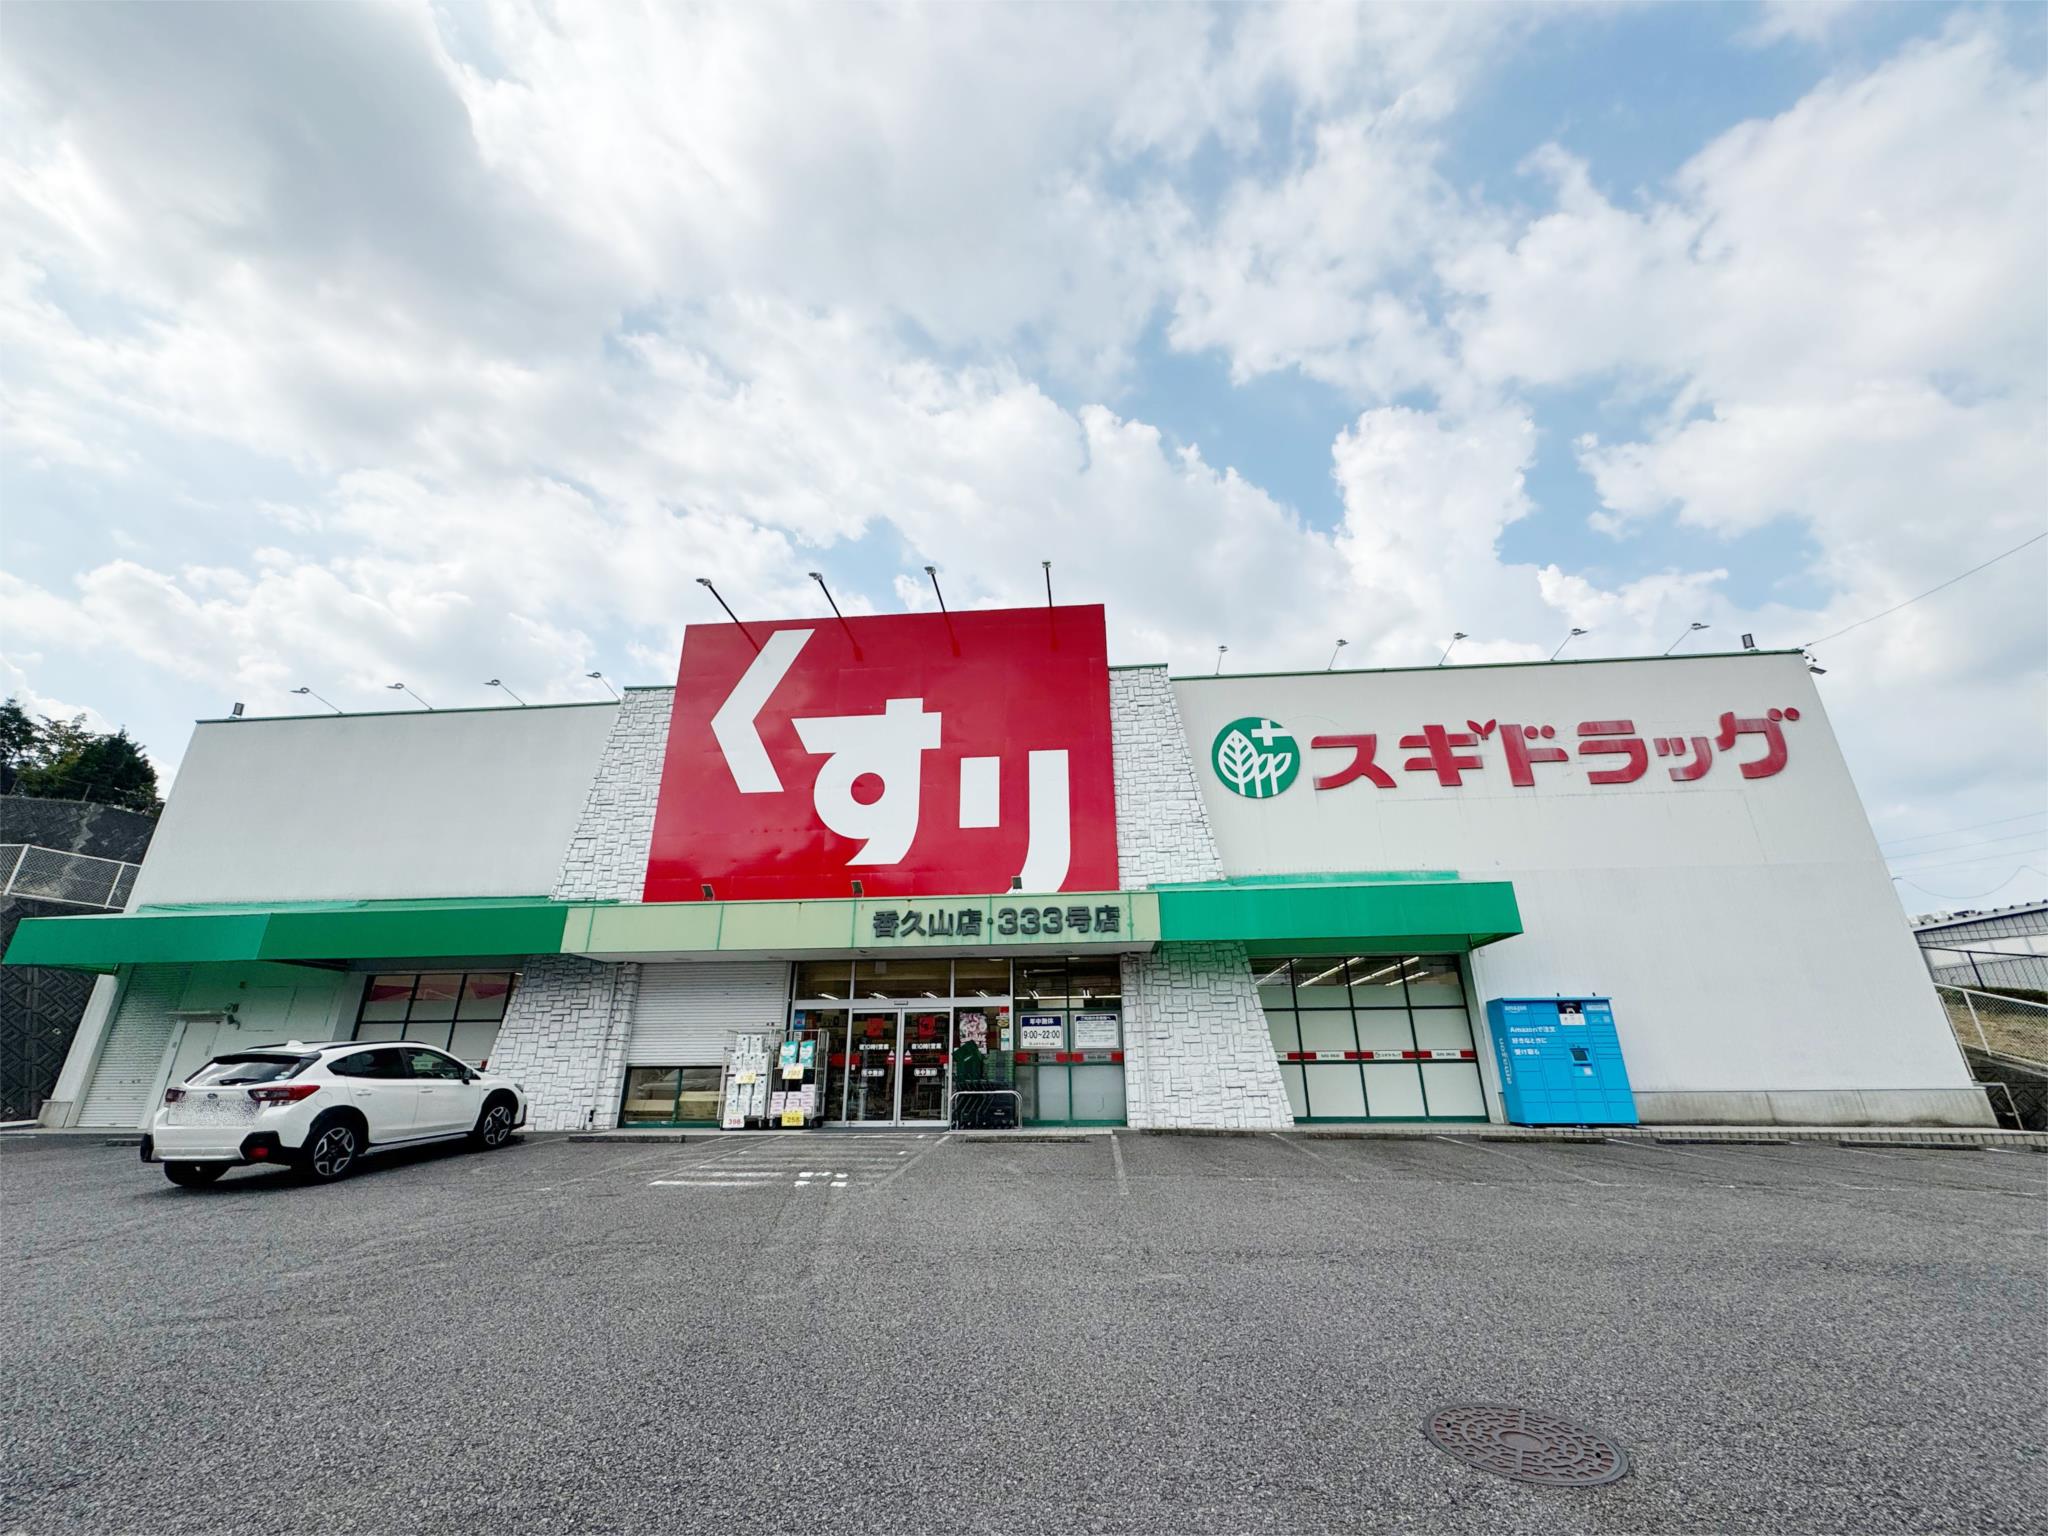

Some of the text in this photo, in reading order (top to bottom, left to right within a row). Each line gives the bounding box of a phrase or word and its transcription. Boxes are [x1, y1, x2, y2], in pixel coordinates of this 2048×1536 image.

[710, 629, 1071, 894] くすり
[1311, 707, 1800, 790] スギドラッグ
